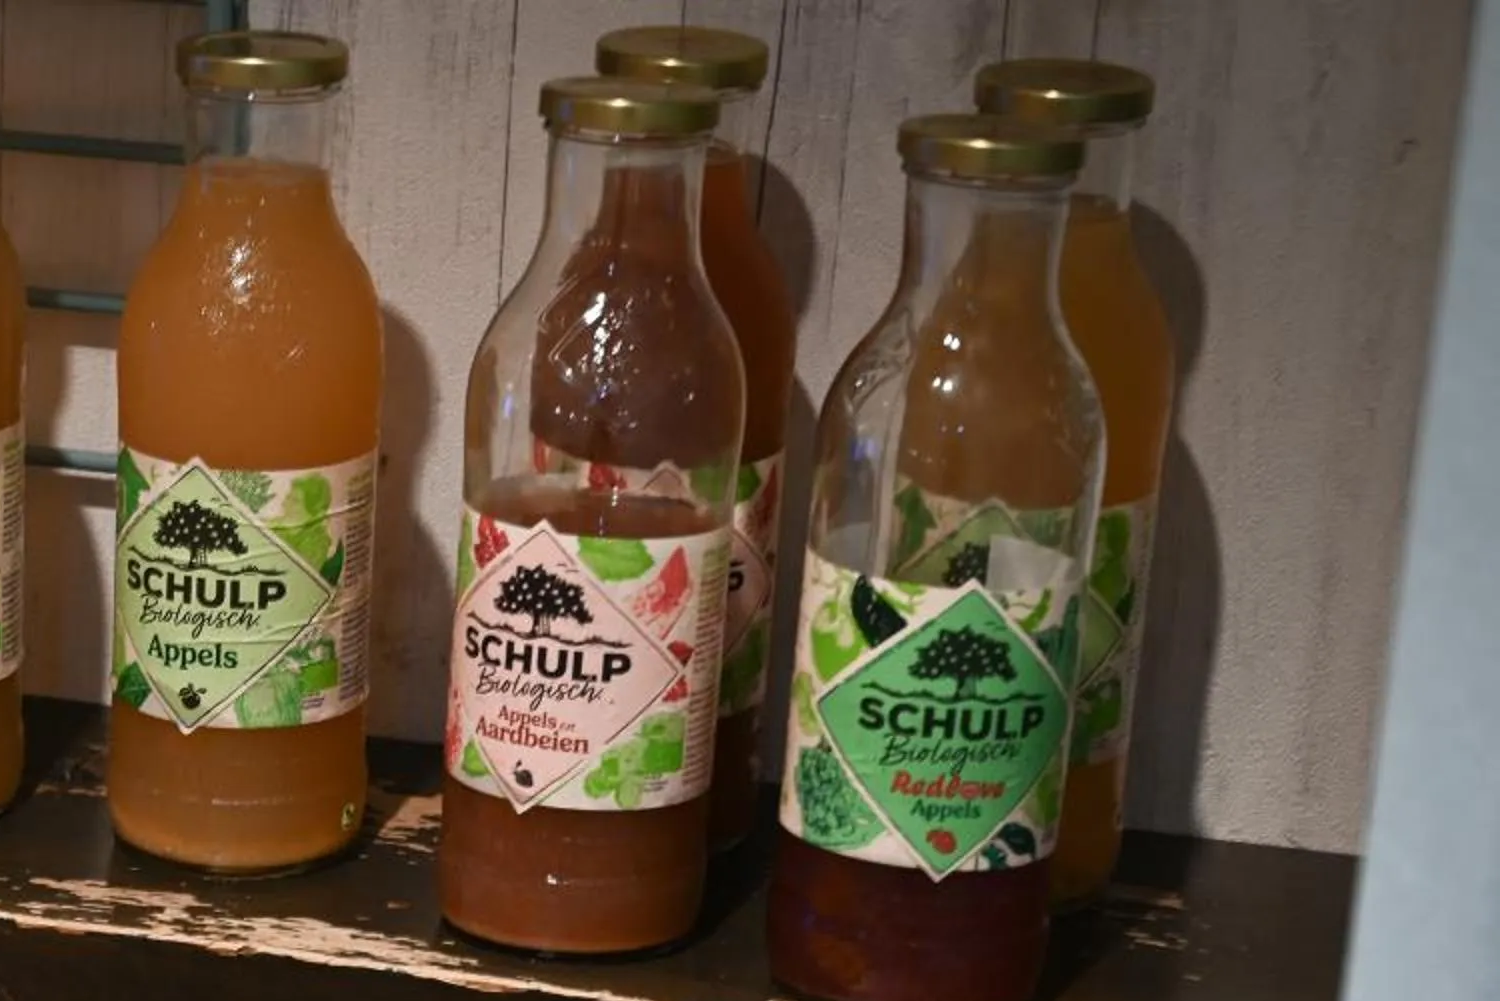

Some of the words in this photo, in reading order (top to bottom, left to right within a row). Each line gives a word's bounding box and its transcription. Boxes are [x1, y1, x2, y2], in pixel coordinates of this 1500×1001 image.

[127, 559, 287, 610] SCHULP
[139, 592, 260, 639] Biologisch
[147, 634, 239, 670] Appels
[464, 626, 632, 683] SCHULP
[476, 660, 603, 711] Biologisch
[475, 714, 590, 754] Aardbeien
[498, 704, 557, 729] Appels
[858, 697, 1045, 742] SCHULP
[879, 733, 1022, 776] Biologisch
[910, 798, 982, 822] Appels
